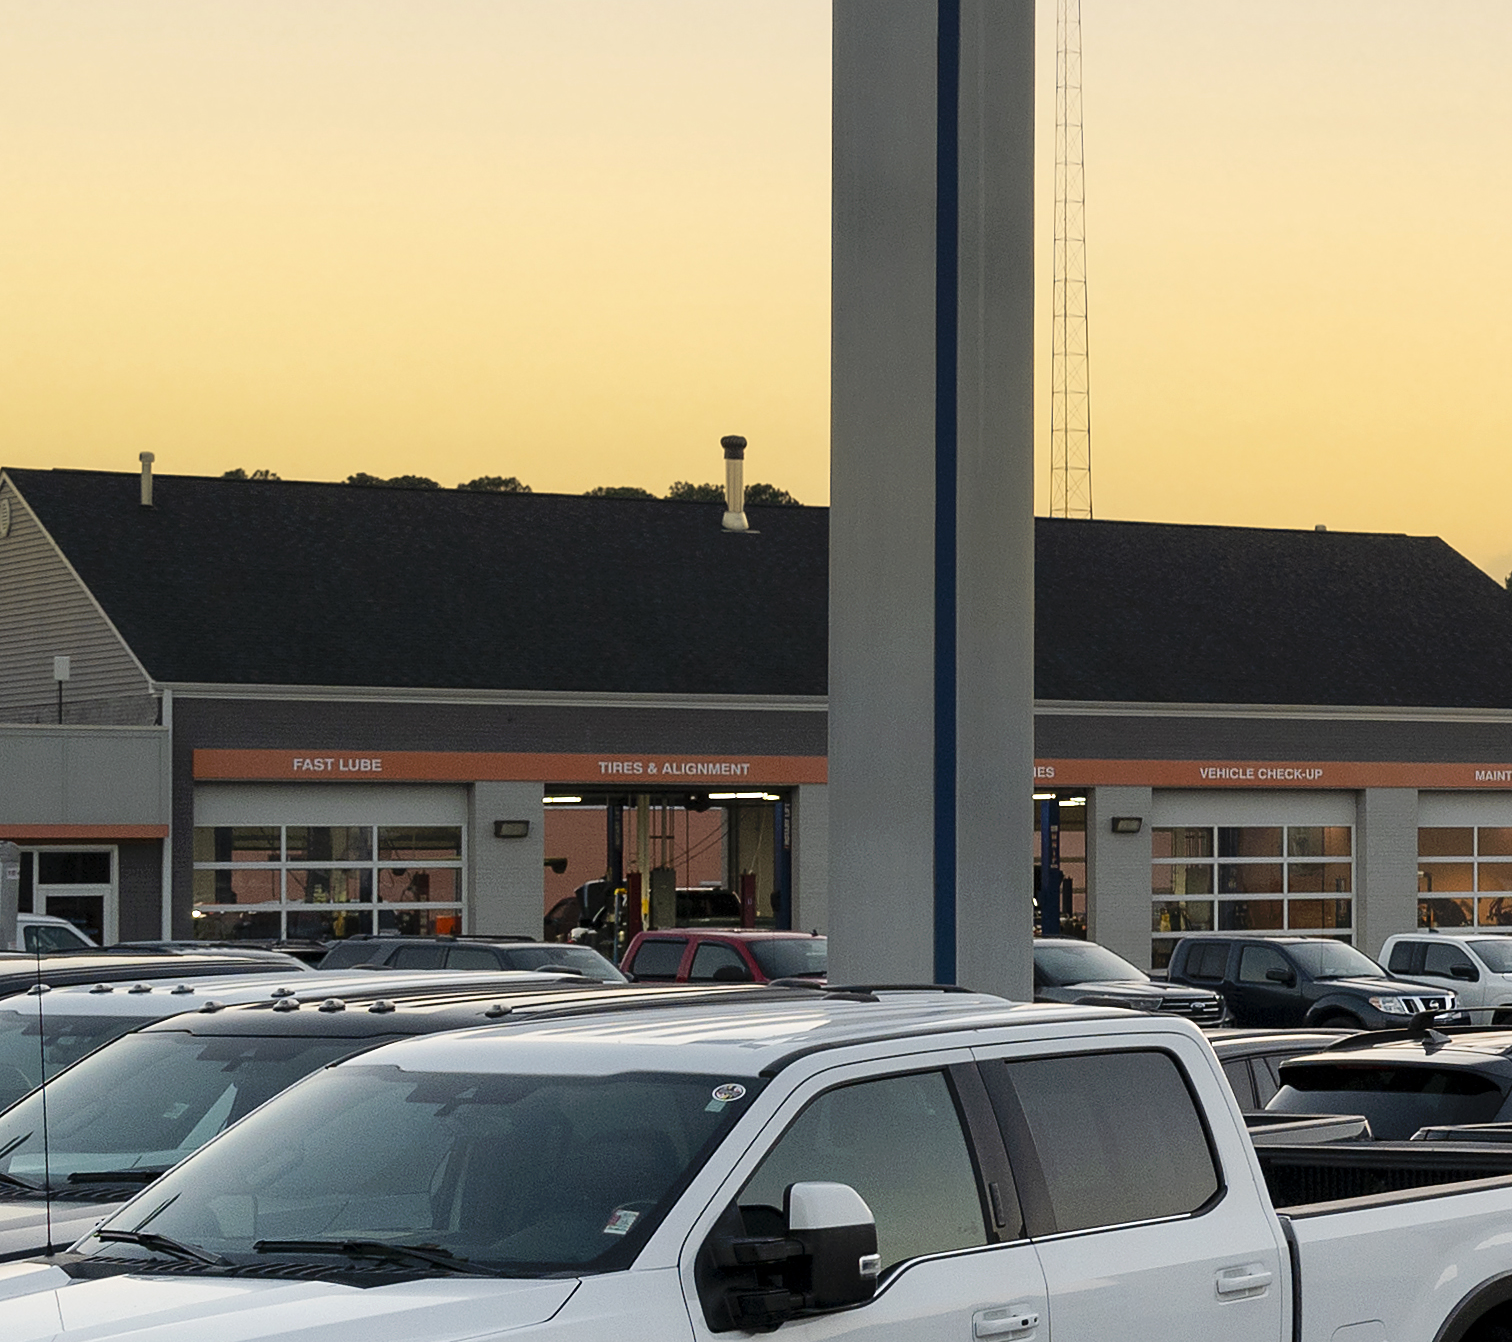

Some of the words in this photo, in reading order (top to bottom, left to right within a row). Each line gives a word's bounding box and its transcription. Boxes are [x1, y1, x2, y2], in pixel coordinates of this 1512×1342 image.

[293, 758, 335, 771] FAST
[339, 758, 383, 772] LUBE
[598, 761, 644, 775] TIRES
[647, 762, 658, 775] &
[661, 762, 751, 776] ALIGNMENT
[1199, 767, 1255, 780] VEHICLE
[1257, 768, 1324, 781] CHECK-UP
